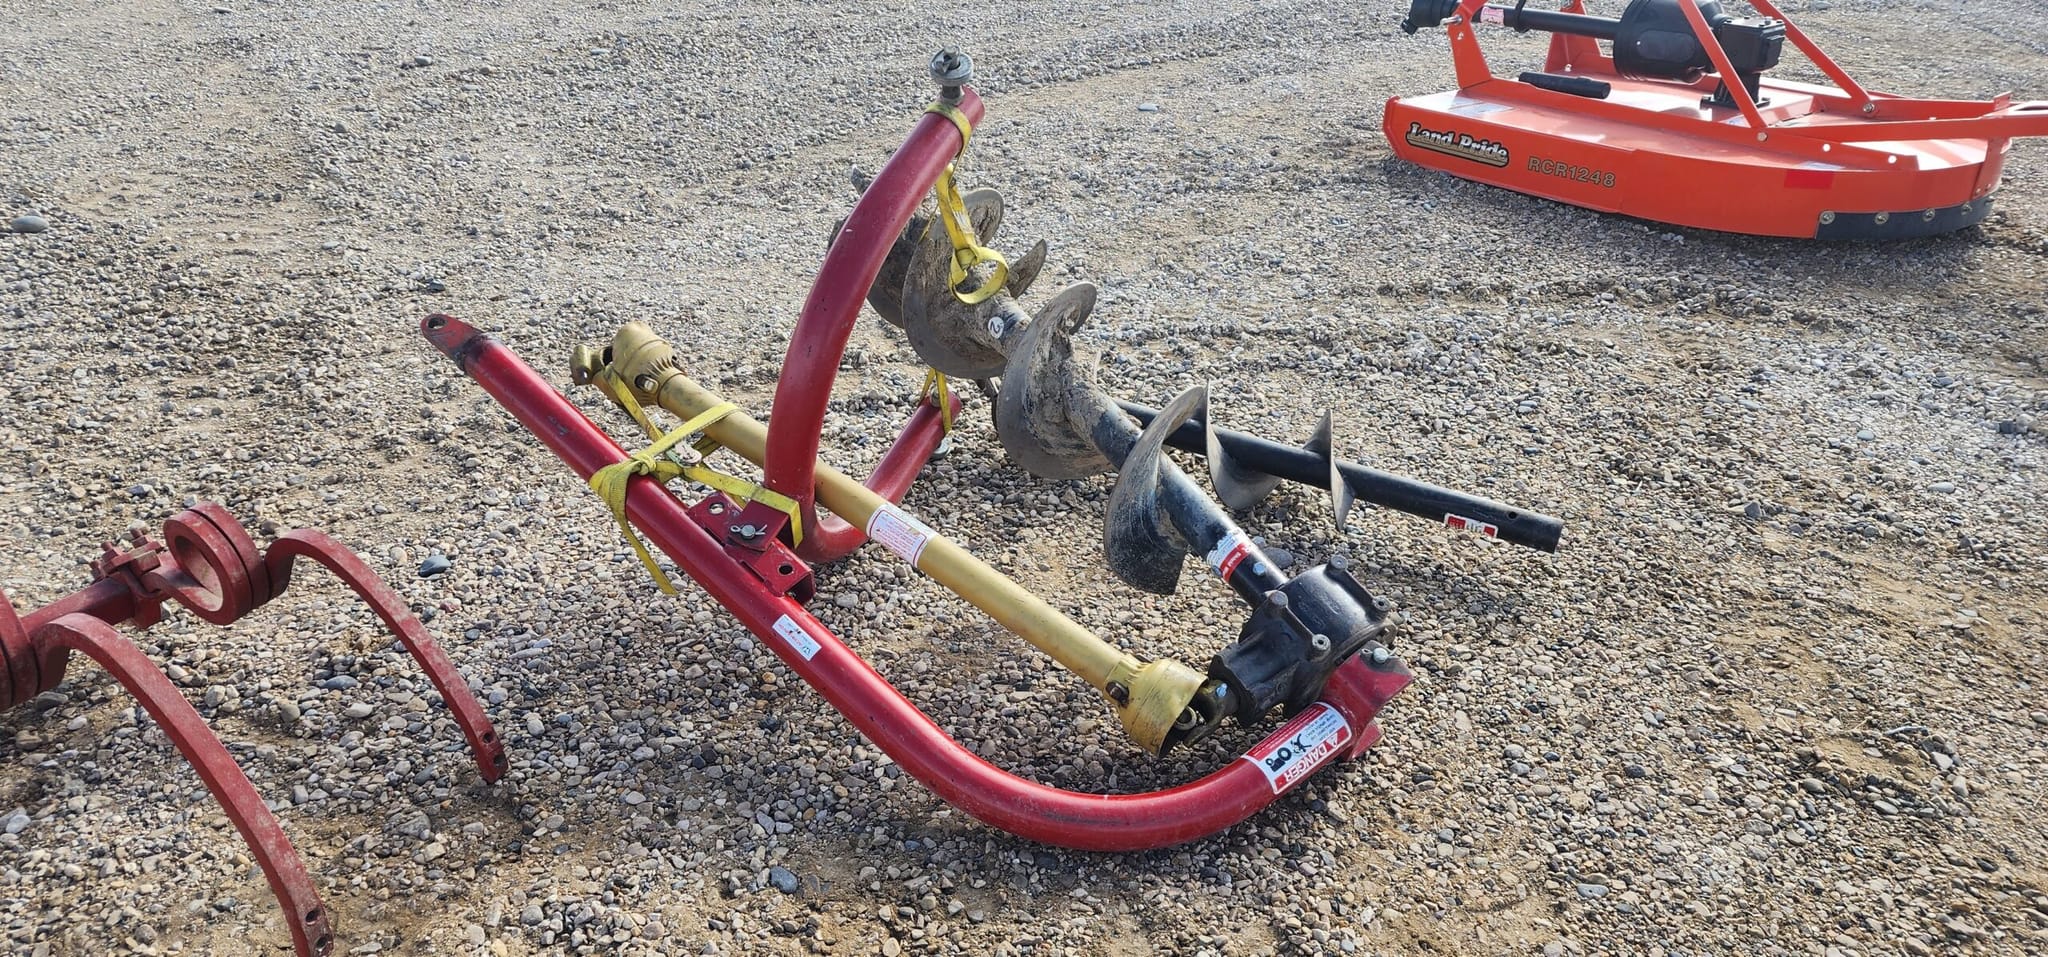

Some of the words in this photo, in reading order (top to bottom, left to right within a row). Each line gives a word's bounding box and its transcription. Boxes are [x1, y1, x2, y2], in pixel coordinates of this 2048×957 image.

[1409, 122, 1454, 147] Land
[1458, 133, 1508, 160] Pride
[1528, 157, 1616, 188] RCR1248
[1284, 743, 1327, 782] DANGER
